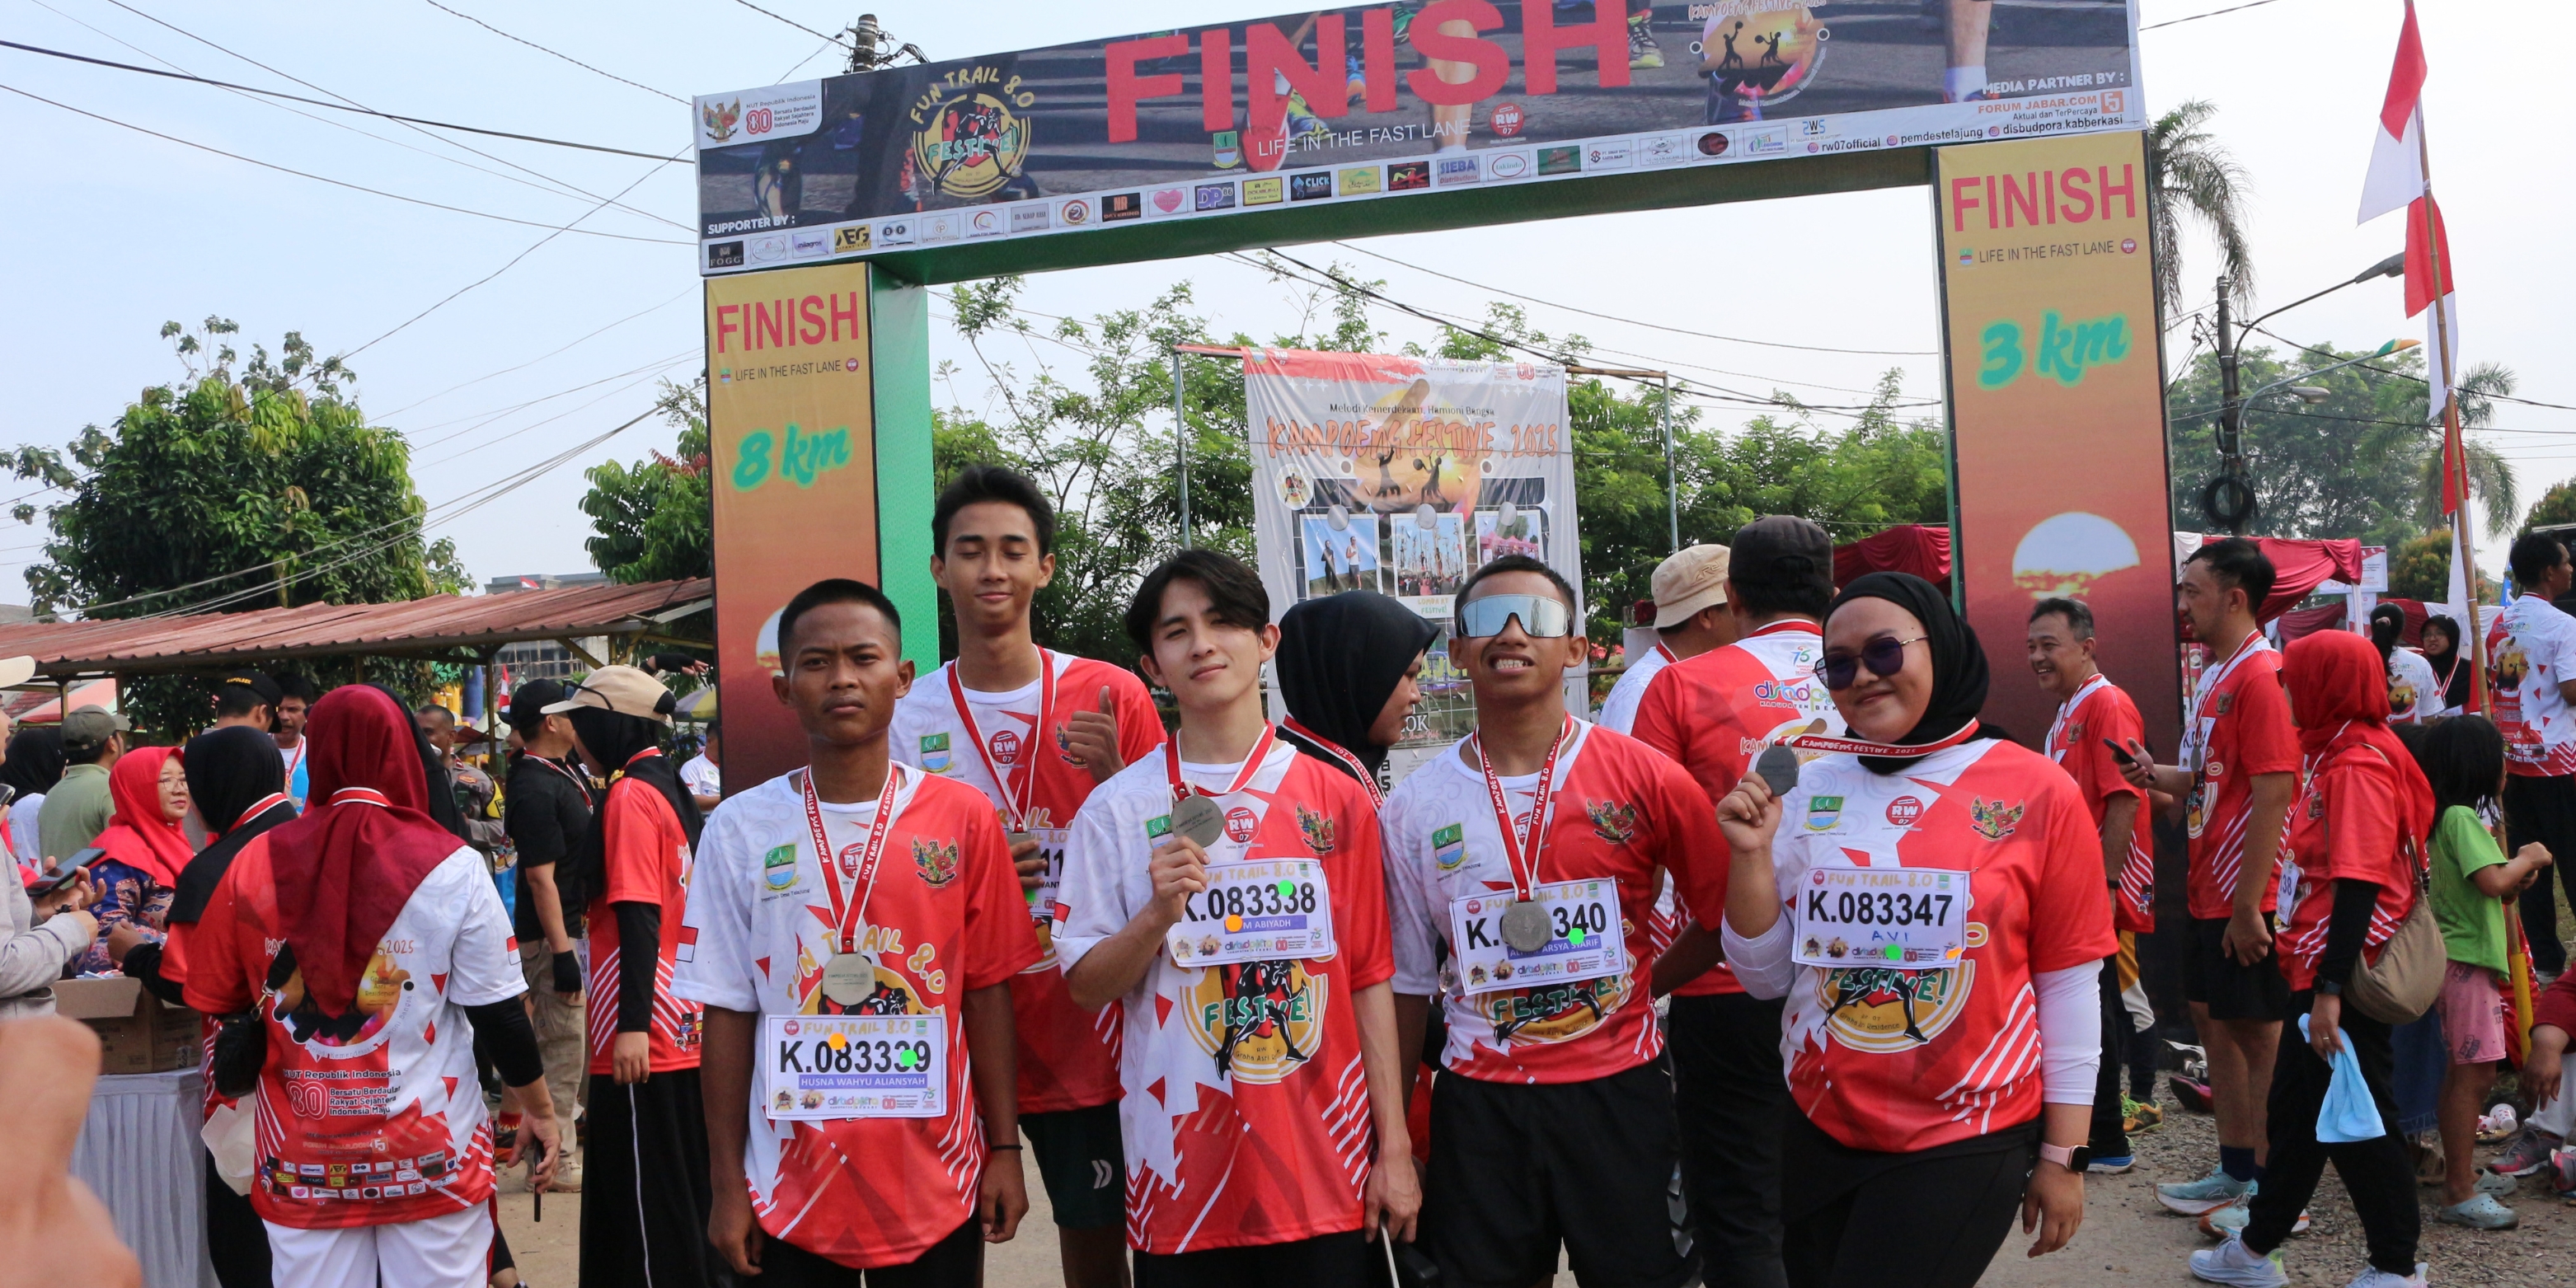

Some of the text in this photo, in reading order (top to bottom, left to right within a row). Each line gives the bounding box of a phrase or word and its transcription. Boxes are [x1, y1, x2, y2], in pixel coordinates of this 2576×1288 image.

[1105, 0, 1631, 143] FINISH
[1982, 72, 2116, 95] MEDIA PARTNER BY
[760, 98, 786, 108] Republik
[786, 94, 816, 103] Indonesia
[910, 66, 1035, 124] FUN TRAIL 8.0
[793, 105, 817, 113] Berdaulat
[1978, 95, 2097, 115] FORUM JABAR.COM
[774, 111, 814, 123] Rakyat Sejahtera
[1494, 112, 1518, 124] RW
[2013, 106, 2098, 120] Aktual dan TerPercaya
[746, 108, 772, 135] 80
[797, 119, 809, 128] Maju
[1258, 119, 1472, 158] LIFE IN THE FAST LANE
[1502, 127, 1513, 135] 07
[1822, 137, 1881, 152] rw07official
[1900, 127, 1983, 146] pemdestelajung
[2002, 114, 2123, 135] disbudpora.kabberkasi
[1440, 159, 1476, 174] SIEBA
[1495, 162, 1523, 171] takindo
[1305, 176, 1330, 187] CLICK
[1198, 188, 1223, 208] DP
[1951, 163, 2136, 232] FINISH
[707, 214, 789, 235] SUPPORTER BY
[797, 240, 823, 249] milagros
[1979, 240, 2114, 263] LIFE IN THE FAST LANE
[710, 256, 742, 267] FOGG
[716, 292, 859, 354] FINISH
[1978, 311, 2130, 387] 3 km
[735, 360, 841, 382] LIFE IN THE FAST LANE
[1330, 403, 1360, 414] Melodi
[1428, 405, 1464, 415] Harmoni
[1466, 405, 1494, 418] Bangsa
[1266, 415, 1558, 460] KAMPOENG FESTIVE 2025
[732, 423, 852, 490] 8 km
[1420, 605, 1448, 615] FESTIVE!
[1759, 700, 1809, 710] KABUPATEN
[993, 740, 1016, 753] RW
[1801, 740, 1852, 751] KAMPOENG
[1853, 743, 1889, 754] FESTIVE
[1002, 755, 1012, 763] 07
[1486, 769, 1506, 814] KAMPOENG
[1532, 767, 1550, 825] FUN TRAIL 8.0
[1892, 805, 1919, 816] RW
[861, 780, 895, 880] FUN TRAIL 8.0 FESTIVE!
[1228, 817, 1254, 831] RW
[809, 815, 831, 864] KAMPOENG
[1238, 833, 1250, 842] 07
[1228, 862, 1296, 881] TRAIL 8.0
[1828, 872, 1933, 888] FUN TRAIL 8.0
[1560, 885, 1584, 900] 8.0
[1185, 882, 1316, 922] K.083338
[1808, 889, 1953, 927] K.083347
[1254, 919, 1292, 930] ABIYADH
[1871, 930, 1909, 943] AVI
[386, 939, 415, 954] 2025
[1542, 943, 1570, 953] ARSYA
[820, 925, 946, 995] TAIL 8.0
[1493, 974, 1622, 1022] FESTIE!
[803, 1019, 911, 1035] FUN TRAIL 8.0
[1866, 1023, 1900, 1031] Residence
[780, 1040, 931, 1074] K.083339
[283, 1069, 401, 1080] HUT Republik Indonesia
[800, 1076, 926, 1087] HUSNA WAHYU ALIANSYAH
[330, 1086, 401, 1096] Bersatu Berdaulat
[287, 1080, 328, 1121] 80
[330, 1095, 396, 1108] Rakyat Sejahtera
[372, 1106, 391, 1117] Maju
